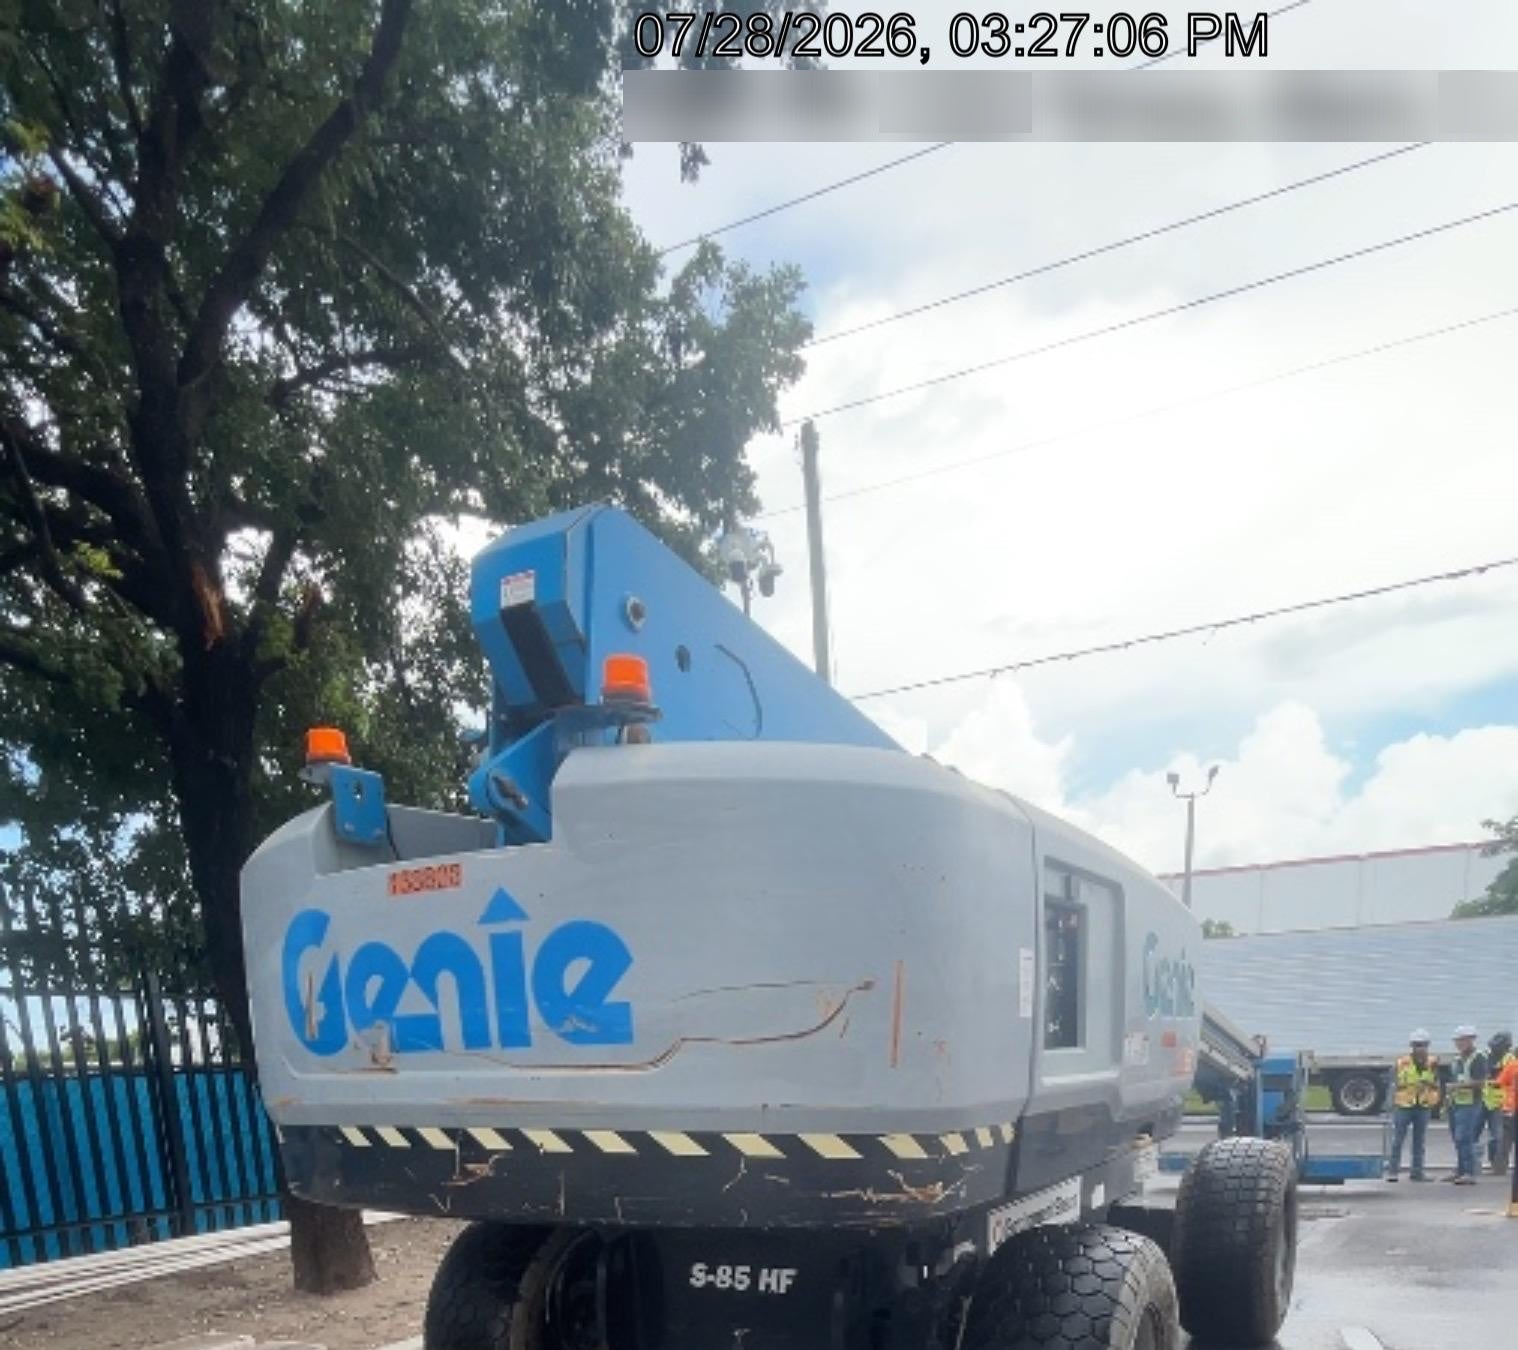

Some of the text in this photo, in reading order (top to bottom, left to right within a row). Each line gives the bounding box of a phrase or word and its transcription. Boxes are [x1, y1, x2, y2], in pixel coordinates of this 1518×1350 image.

[282, 886, 635, 1056] Genie
[689, 1262, 799, 1294] S-85 HF
